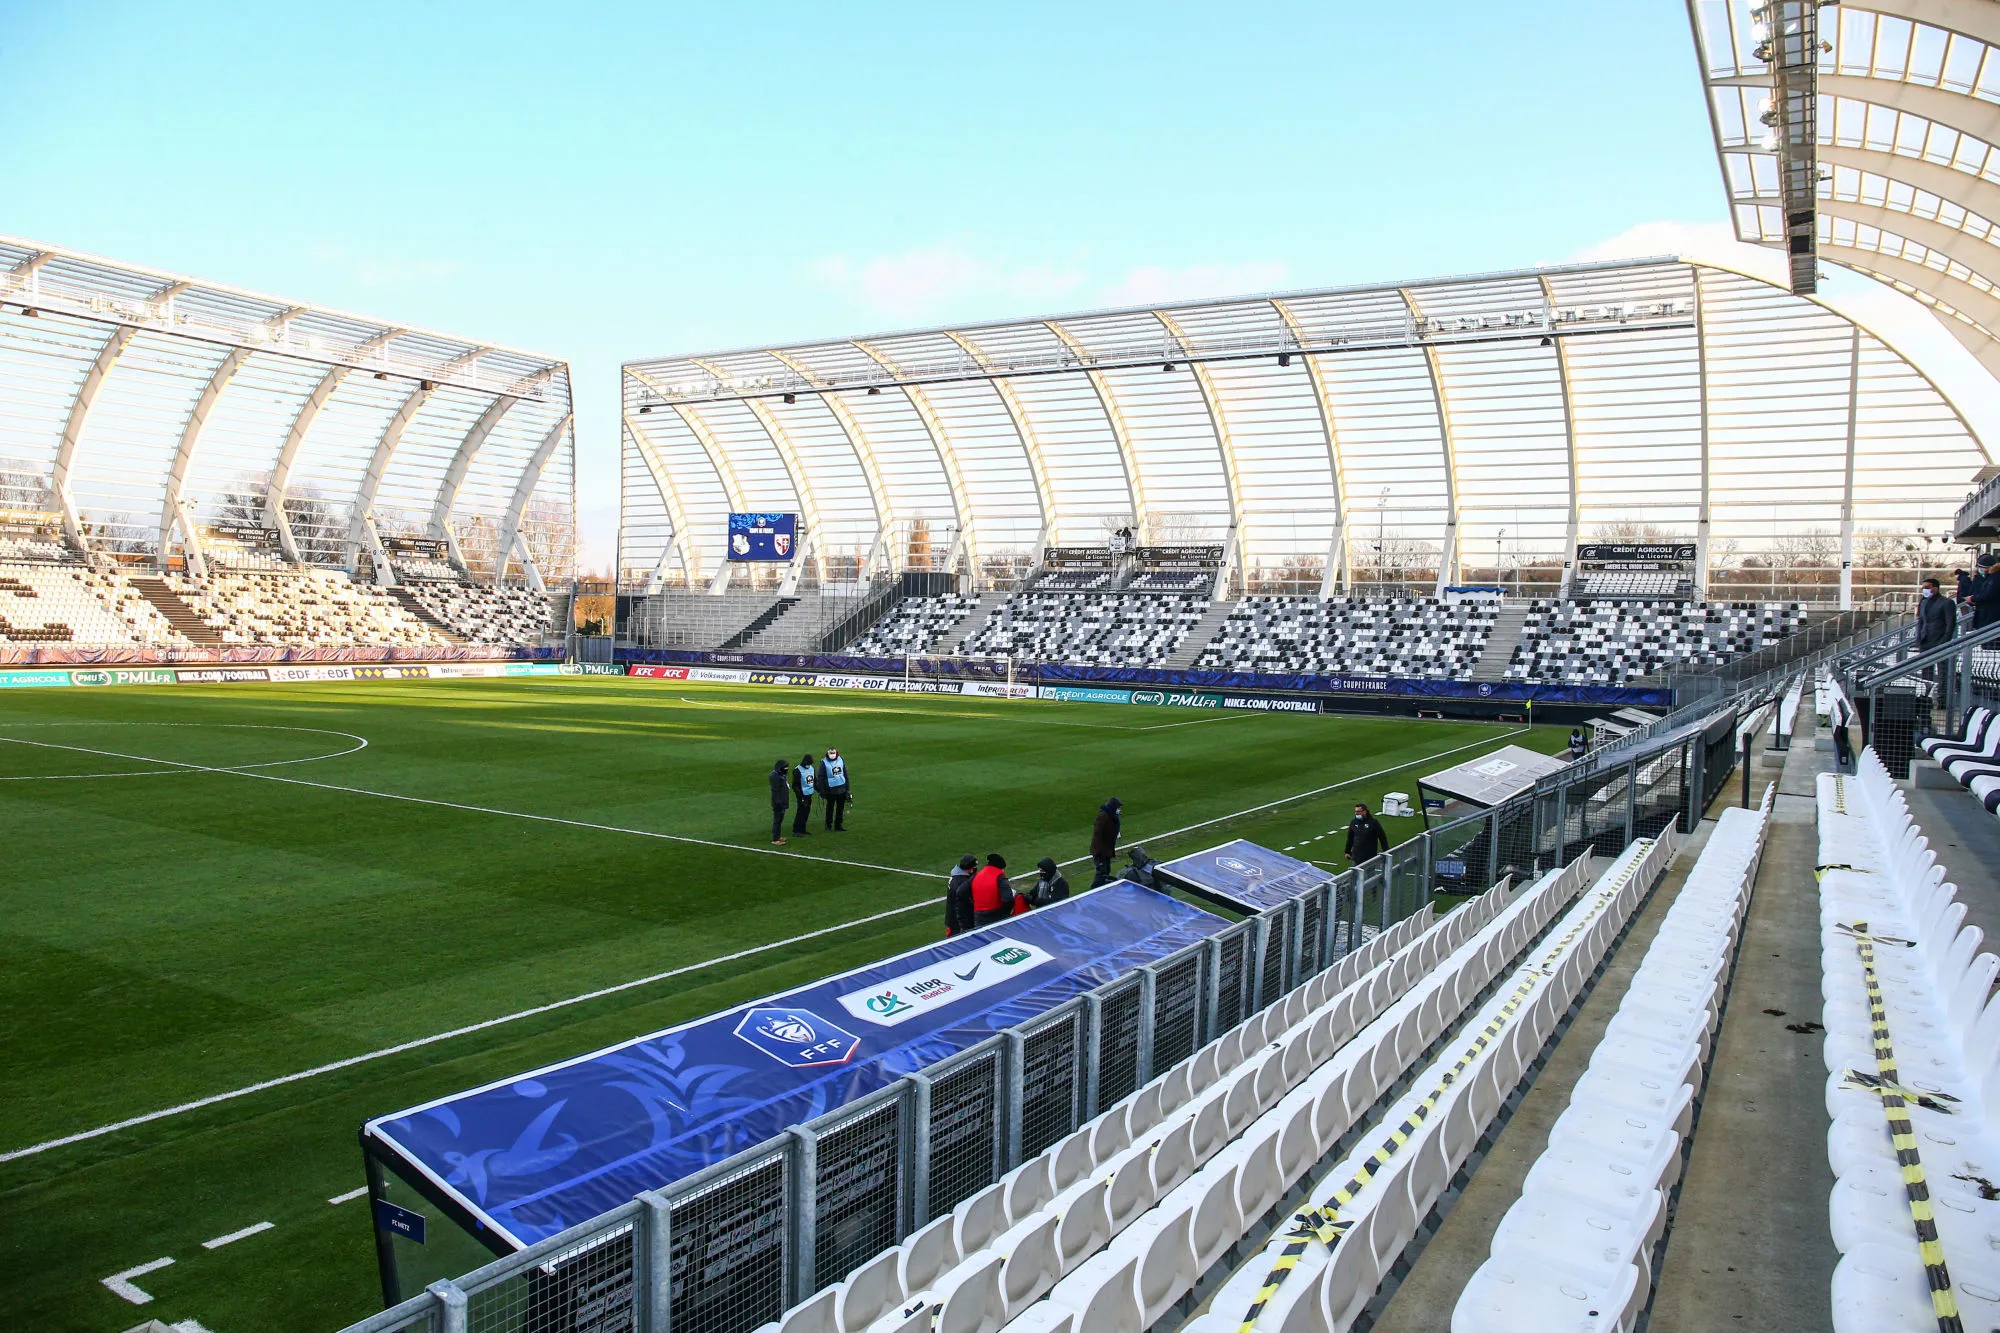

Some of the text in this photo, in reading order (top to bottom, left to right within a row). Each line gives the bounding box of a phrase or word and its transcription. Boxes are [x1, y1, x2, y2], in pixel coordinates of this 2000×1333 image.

[1612, 544, 1636, 553] CRÉDIT
[1842, 561, 1851, 569] F
[635, 667, 655, 677] KFC
[663, 669, 683, 678] KFC
[700, 671, 737, 680] Volkswagen
[11, 675, 67, 684] AGRICOLE
[77, 674, 97, 682] PMU
[1343, 680, 1361, 689] COUPE
[1365, 681, 1387, 690] FRANCE
[1055, 689, 1085, 699] CRÉDIT
[1086, 692, 1127, 701] AGRICOLE
[1135, 693, 1153, 703] PMU
[1223, 697, 1317, 712] NIKE.COM/FOOTBALL
[994, 948, 1019, 964] PMU
[799, 1038, 841, 1060] FFF
[391, 1219, 410, 1232] FC METZ
